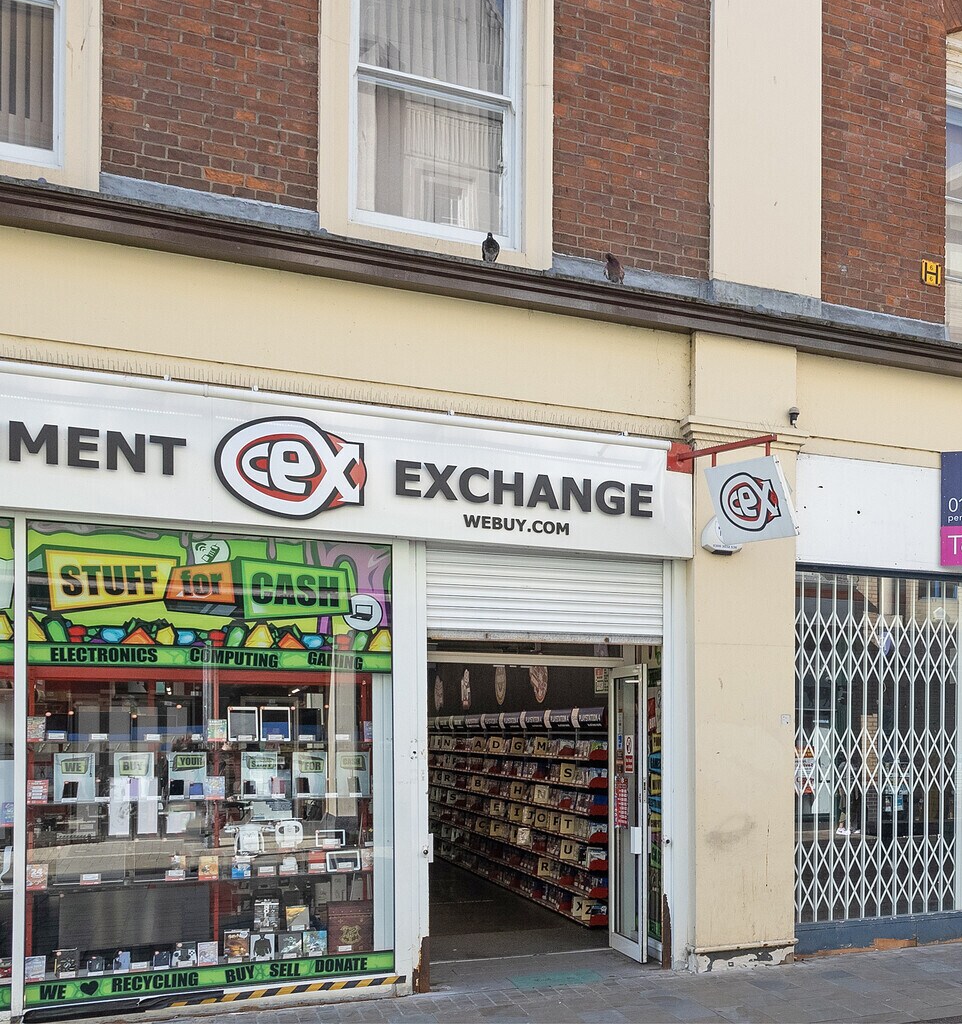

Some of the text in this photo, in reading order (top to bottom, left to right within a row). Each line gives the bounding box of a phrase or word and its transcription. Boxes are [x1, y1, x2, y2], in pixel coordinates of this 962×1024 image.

[925, 262, 938, 284] H
[395, 459, 653, 517] EXCHANGE
[463, 514, 570, 535] WEBUY.COM
[60, 565, 340, 608] STUFF for CASH
[50, 647, 363, 670] ELECTRONICS COMPUTING GAMING
[514, 742, 522, 750] G
[537, 742, 546, 750] M
[123, 761, 144, 771] BUY
[180, 756, 203, 766] YOUR
[304, 761, 321, 771] FOR
[65, 762, 82, 772] WE
[564, 768, 572, 778] S
[564, 819, 572, 829] T
[564, 845, 572, 854] U
[541, 863, 549, 871] R
[225, 957, 368, 983] BUY SELL DONATE
[39, 972, 199, 1000] WE RECYCLING
